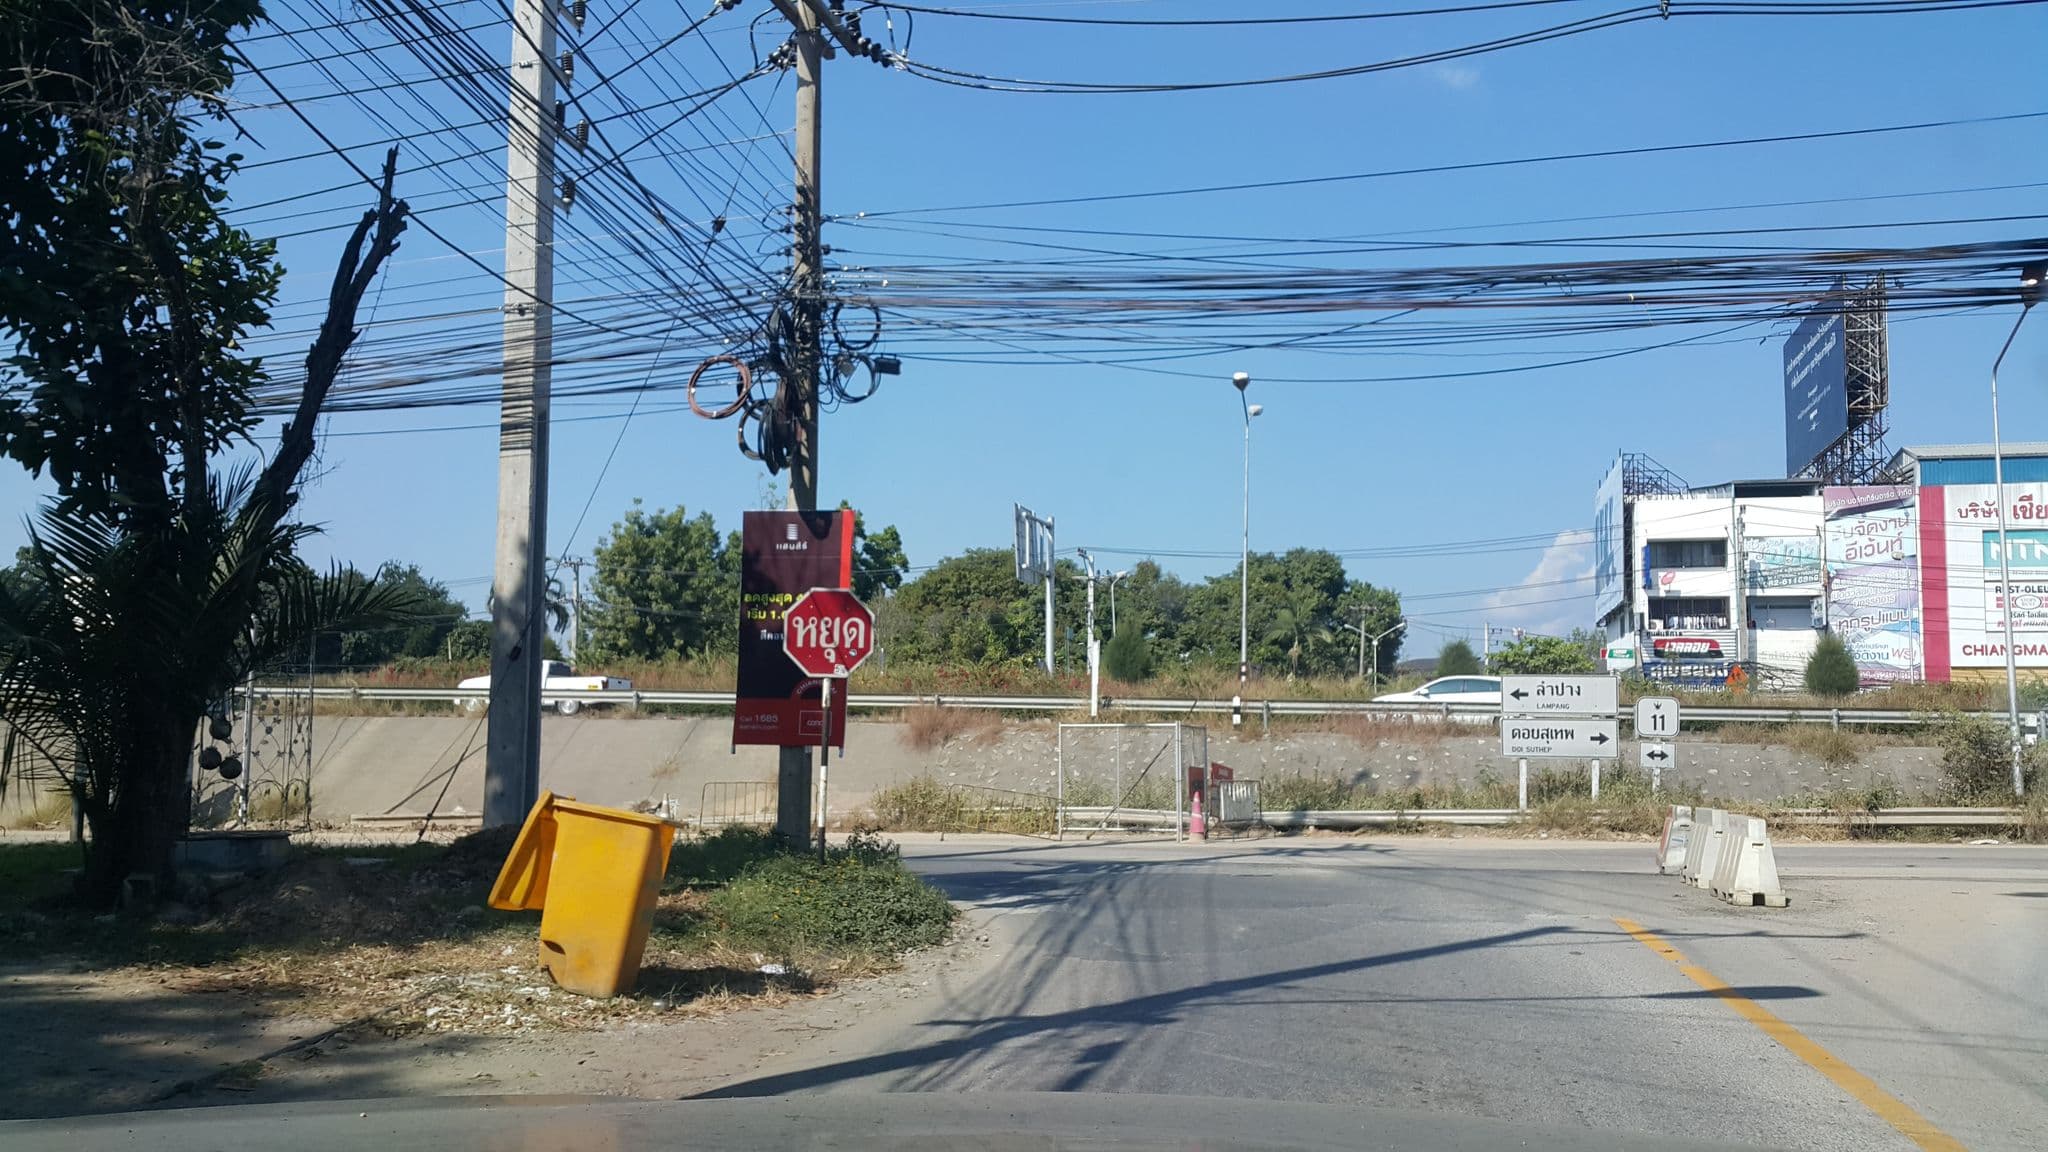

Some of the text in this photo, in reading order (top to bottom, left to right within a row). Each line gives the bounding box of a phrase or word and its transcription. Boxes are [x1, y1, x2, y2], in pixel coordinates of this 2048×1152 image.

[792, 616, 865, 663] หยุด
[1536, 681, 1581, 697] ลำปาง
[1651, 714, 1666, 731] 11
[1511, 727, 1575, 744] ดอยสุเทพ
